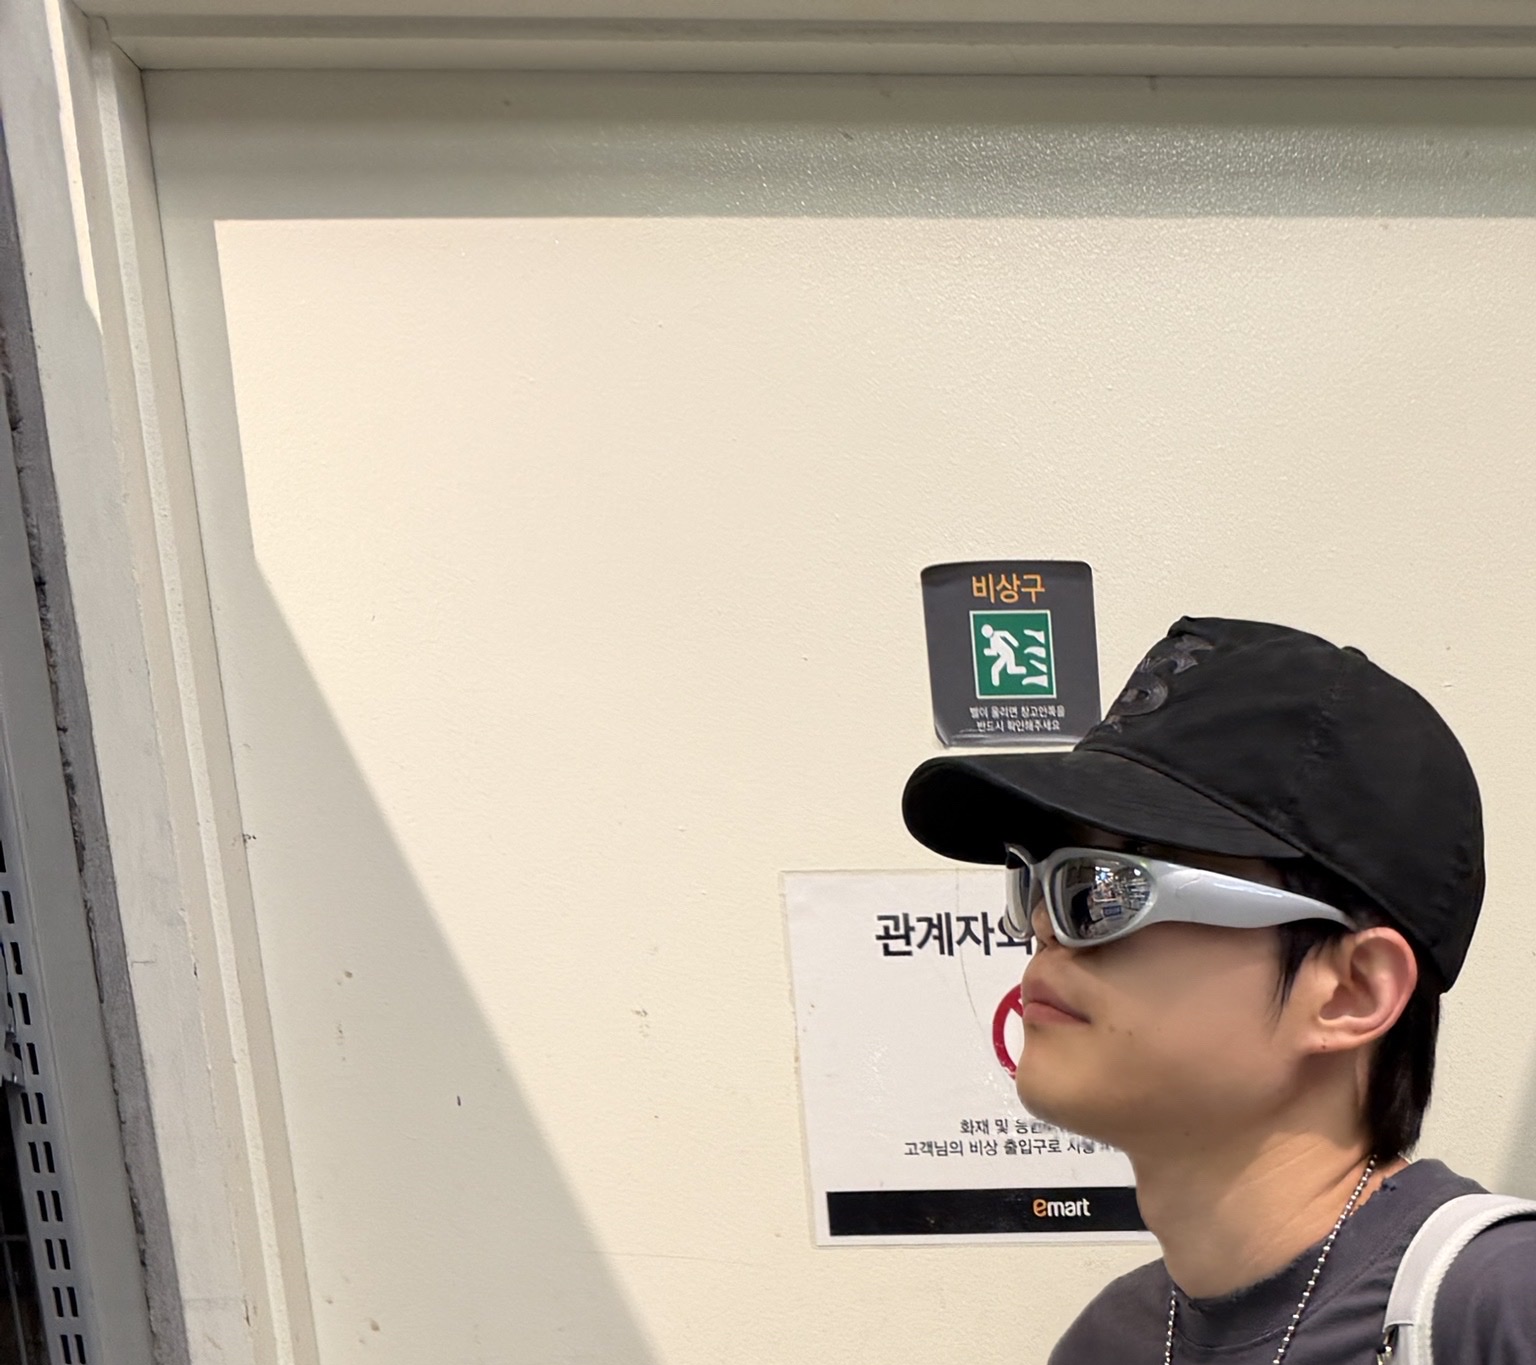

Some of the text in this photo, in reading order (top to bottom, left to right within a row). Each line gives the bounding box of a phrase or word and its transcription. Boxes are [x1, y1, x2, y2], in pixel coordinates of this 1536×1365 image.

[972, 573, 1045, 604] 비상구
[976, 720, 1005, 733] 반드시
[904, 1140, 964, 1157] 고객님의
[969, 1140, 998, 1157] 비상
[1003, 1139, 1062, 1156] 출입구로
[1033, 1198, 1091, 1217] emart
